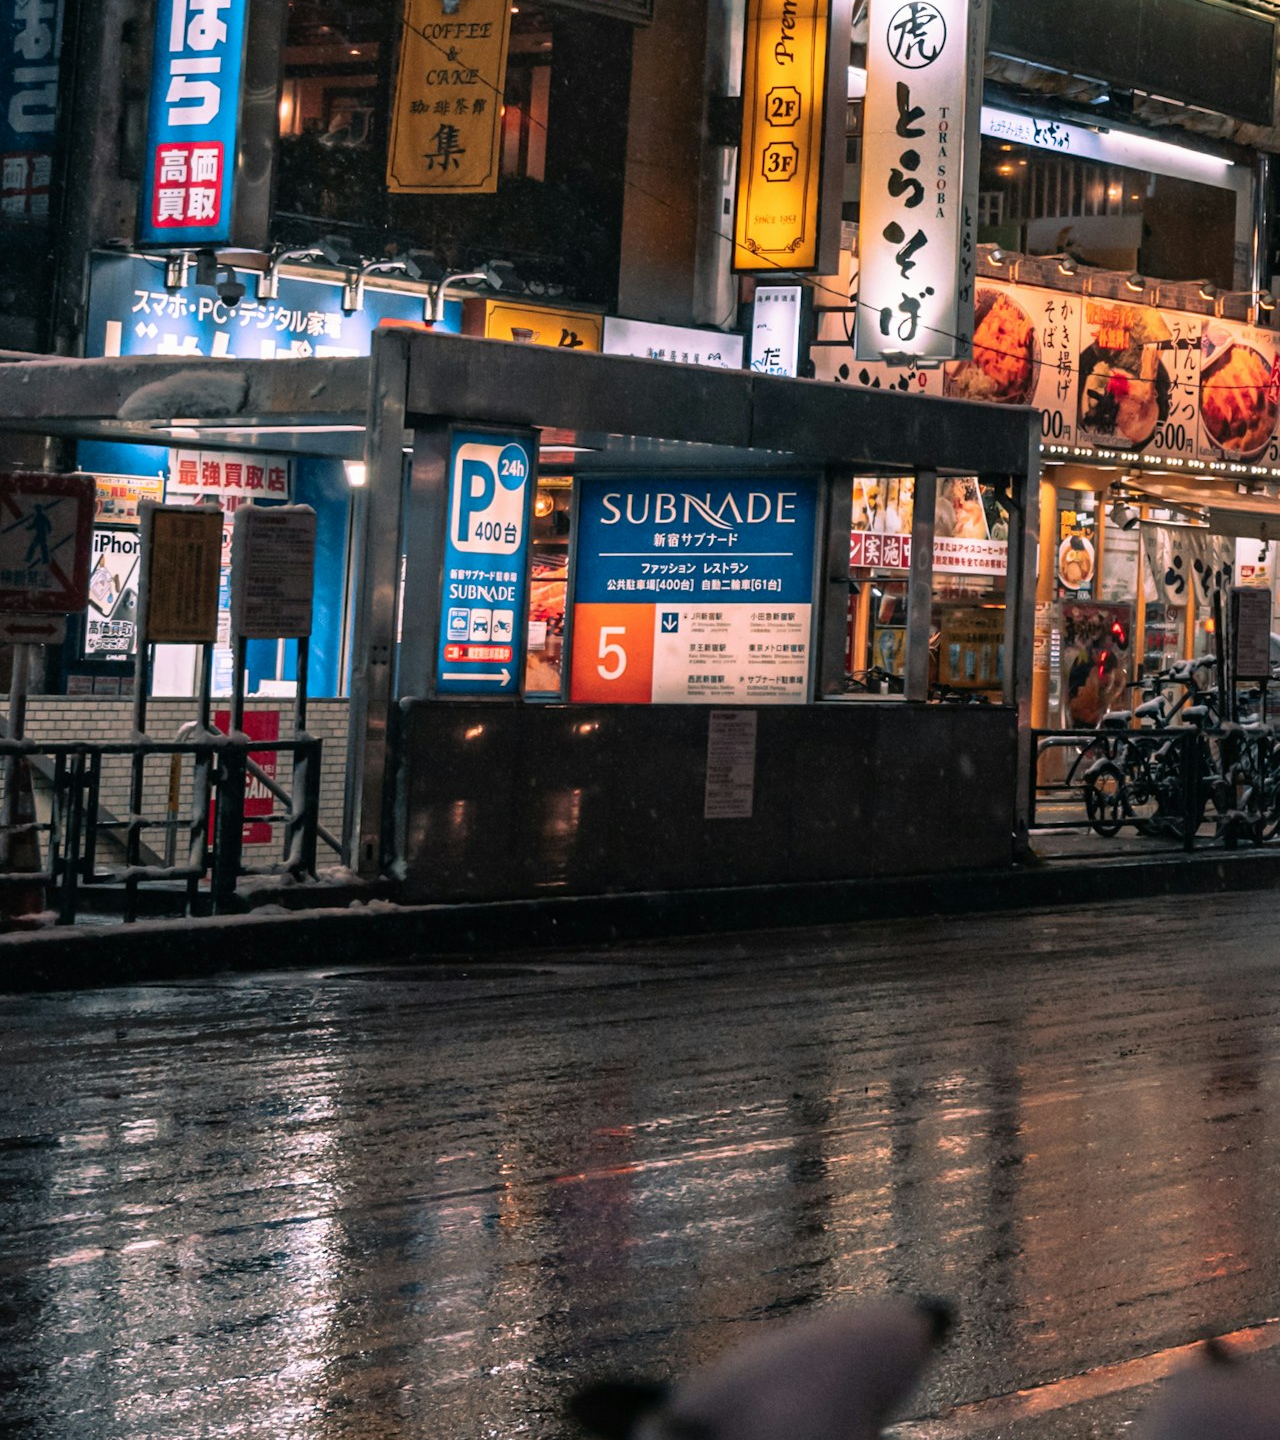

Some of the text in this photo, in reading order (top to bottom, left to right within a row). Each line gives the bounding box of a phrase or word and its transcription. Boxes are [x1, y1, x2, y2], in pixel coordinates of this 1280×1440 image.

[421, 21, 493, 40] COFFEE
[894, 2, 939, 63] 虎
[445, 44, 461, 63] &
[425, 67, 480, 86] CAKE
[409, 97, 487, 117] 珈琲茶館
[772, 97, 796, 119] 2F
[423, 123, 466, 171] 集
[768, 152, 792, 172] 3F
[935, 107, 949, 219] TORA SOBA
[160, 147, 219, 184] 高価
[157, 184, 217, 221] 買取
[879, 81, 935, 342] とらそば
[1042, 300, 1055, 349] そば
[1056, 300, 1074, 403] かき揚げ
[1168, 322, 1182, 417] ラーメン
[1182, 324, 1198, 421] とんこつ
[1154, 422, 1193, 454] 500円
[179, 460, 285, 493] 最強買取店
[501, 458, 524, 477] 24h
[458, 459, 495, 542] P
[600, 492, 797, 530] SUBNADE
[474, 521, 517, 544] 400台
[653, 533, 738, 548] 新宿サブナード
[641, 562, 748, 575] ファッション レストラン
[449, 584, 515, 602] SUBNADE
[597, 626, 626, 680] 5
